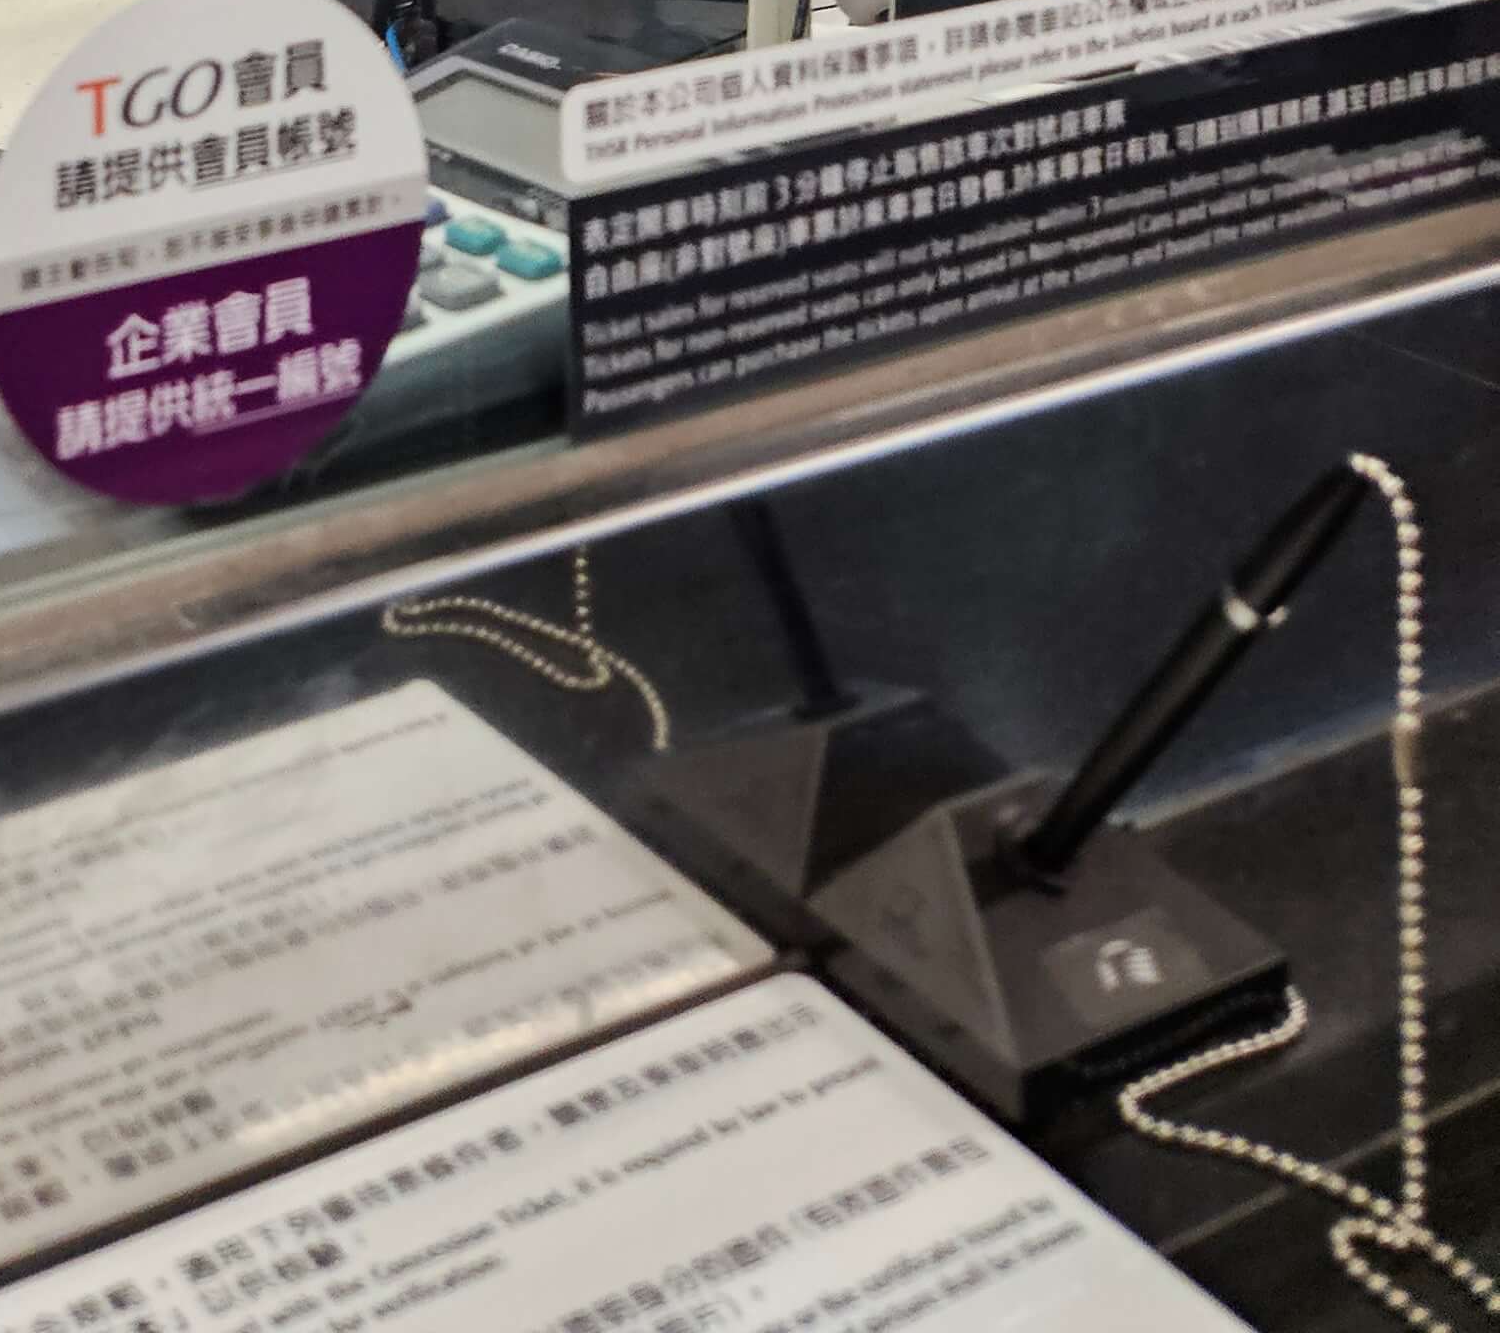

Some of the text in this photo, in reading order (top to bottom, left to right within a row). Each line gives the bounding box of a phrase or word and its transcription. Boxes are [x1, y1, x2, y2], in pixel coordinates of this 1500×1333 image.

[53, 106, 356, 212] 請提供會員帳號
[105, 275, 313, 381] 企業會員
